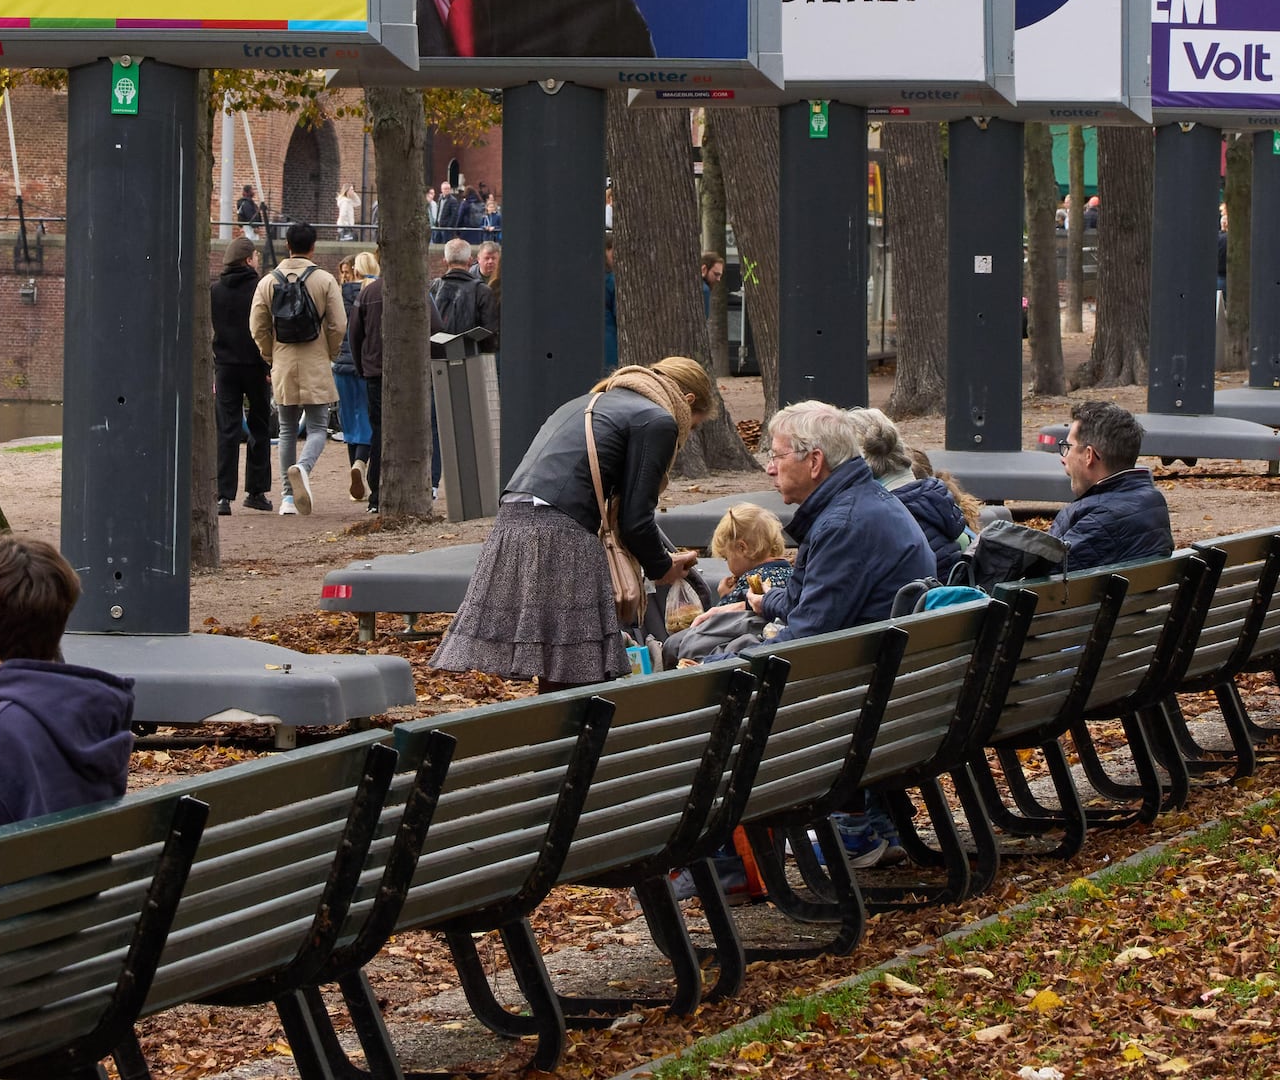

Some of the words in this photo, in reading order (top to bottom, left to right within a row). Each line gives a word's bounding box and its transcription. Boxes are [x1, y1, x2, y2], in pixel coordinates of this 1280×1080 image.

[242, 43, 328, 58] trotter
[1183, 41, 1273, 81] Volt
[618, 71, 688, 83] trotter
[901, 89, 959, 100] trotter
[1048, 108, 1101, 118] trotter
